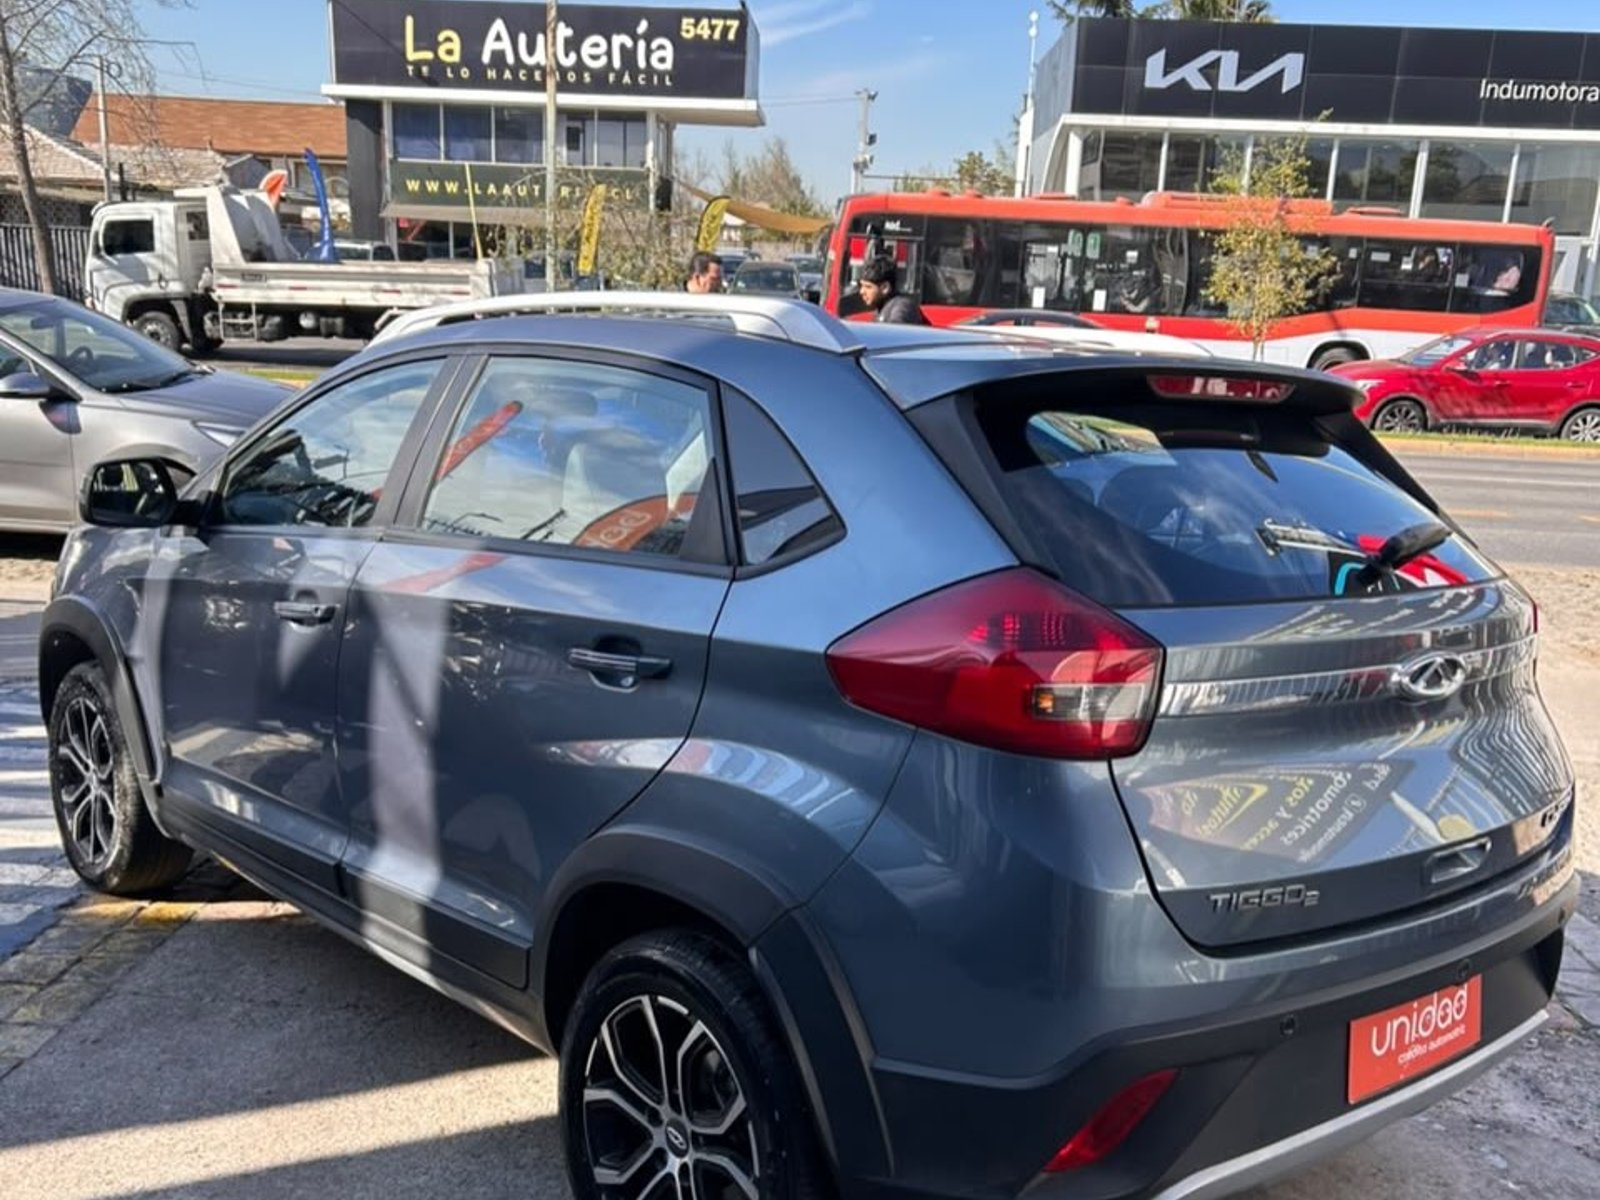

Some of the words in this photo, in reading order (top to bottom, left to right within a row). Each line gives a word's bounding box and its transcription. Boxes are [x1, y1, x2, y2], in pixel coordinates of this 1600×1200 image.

[405, 14, 461, 63] La
[481, 17, 674, 71] Autería
[680, 17, 740, 41] 5477
[406, 65, 429, 77] TE
[446, 67, 470, 79] LO
[608, 70, 673, 87] FÁCIL
[1145, 48, 1304, 94] KIA
[1480, 78, 1600, 101] Indumotora
[1371, 983, 1468, 1057] unidad
